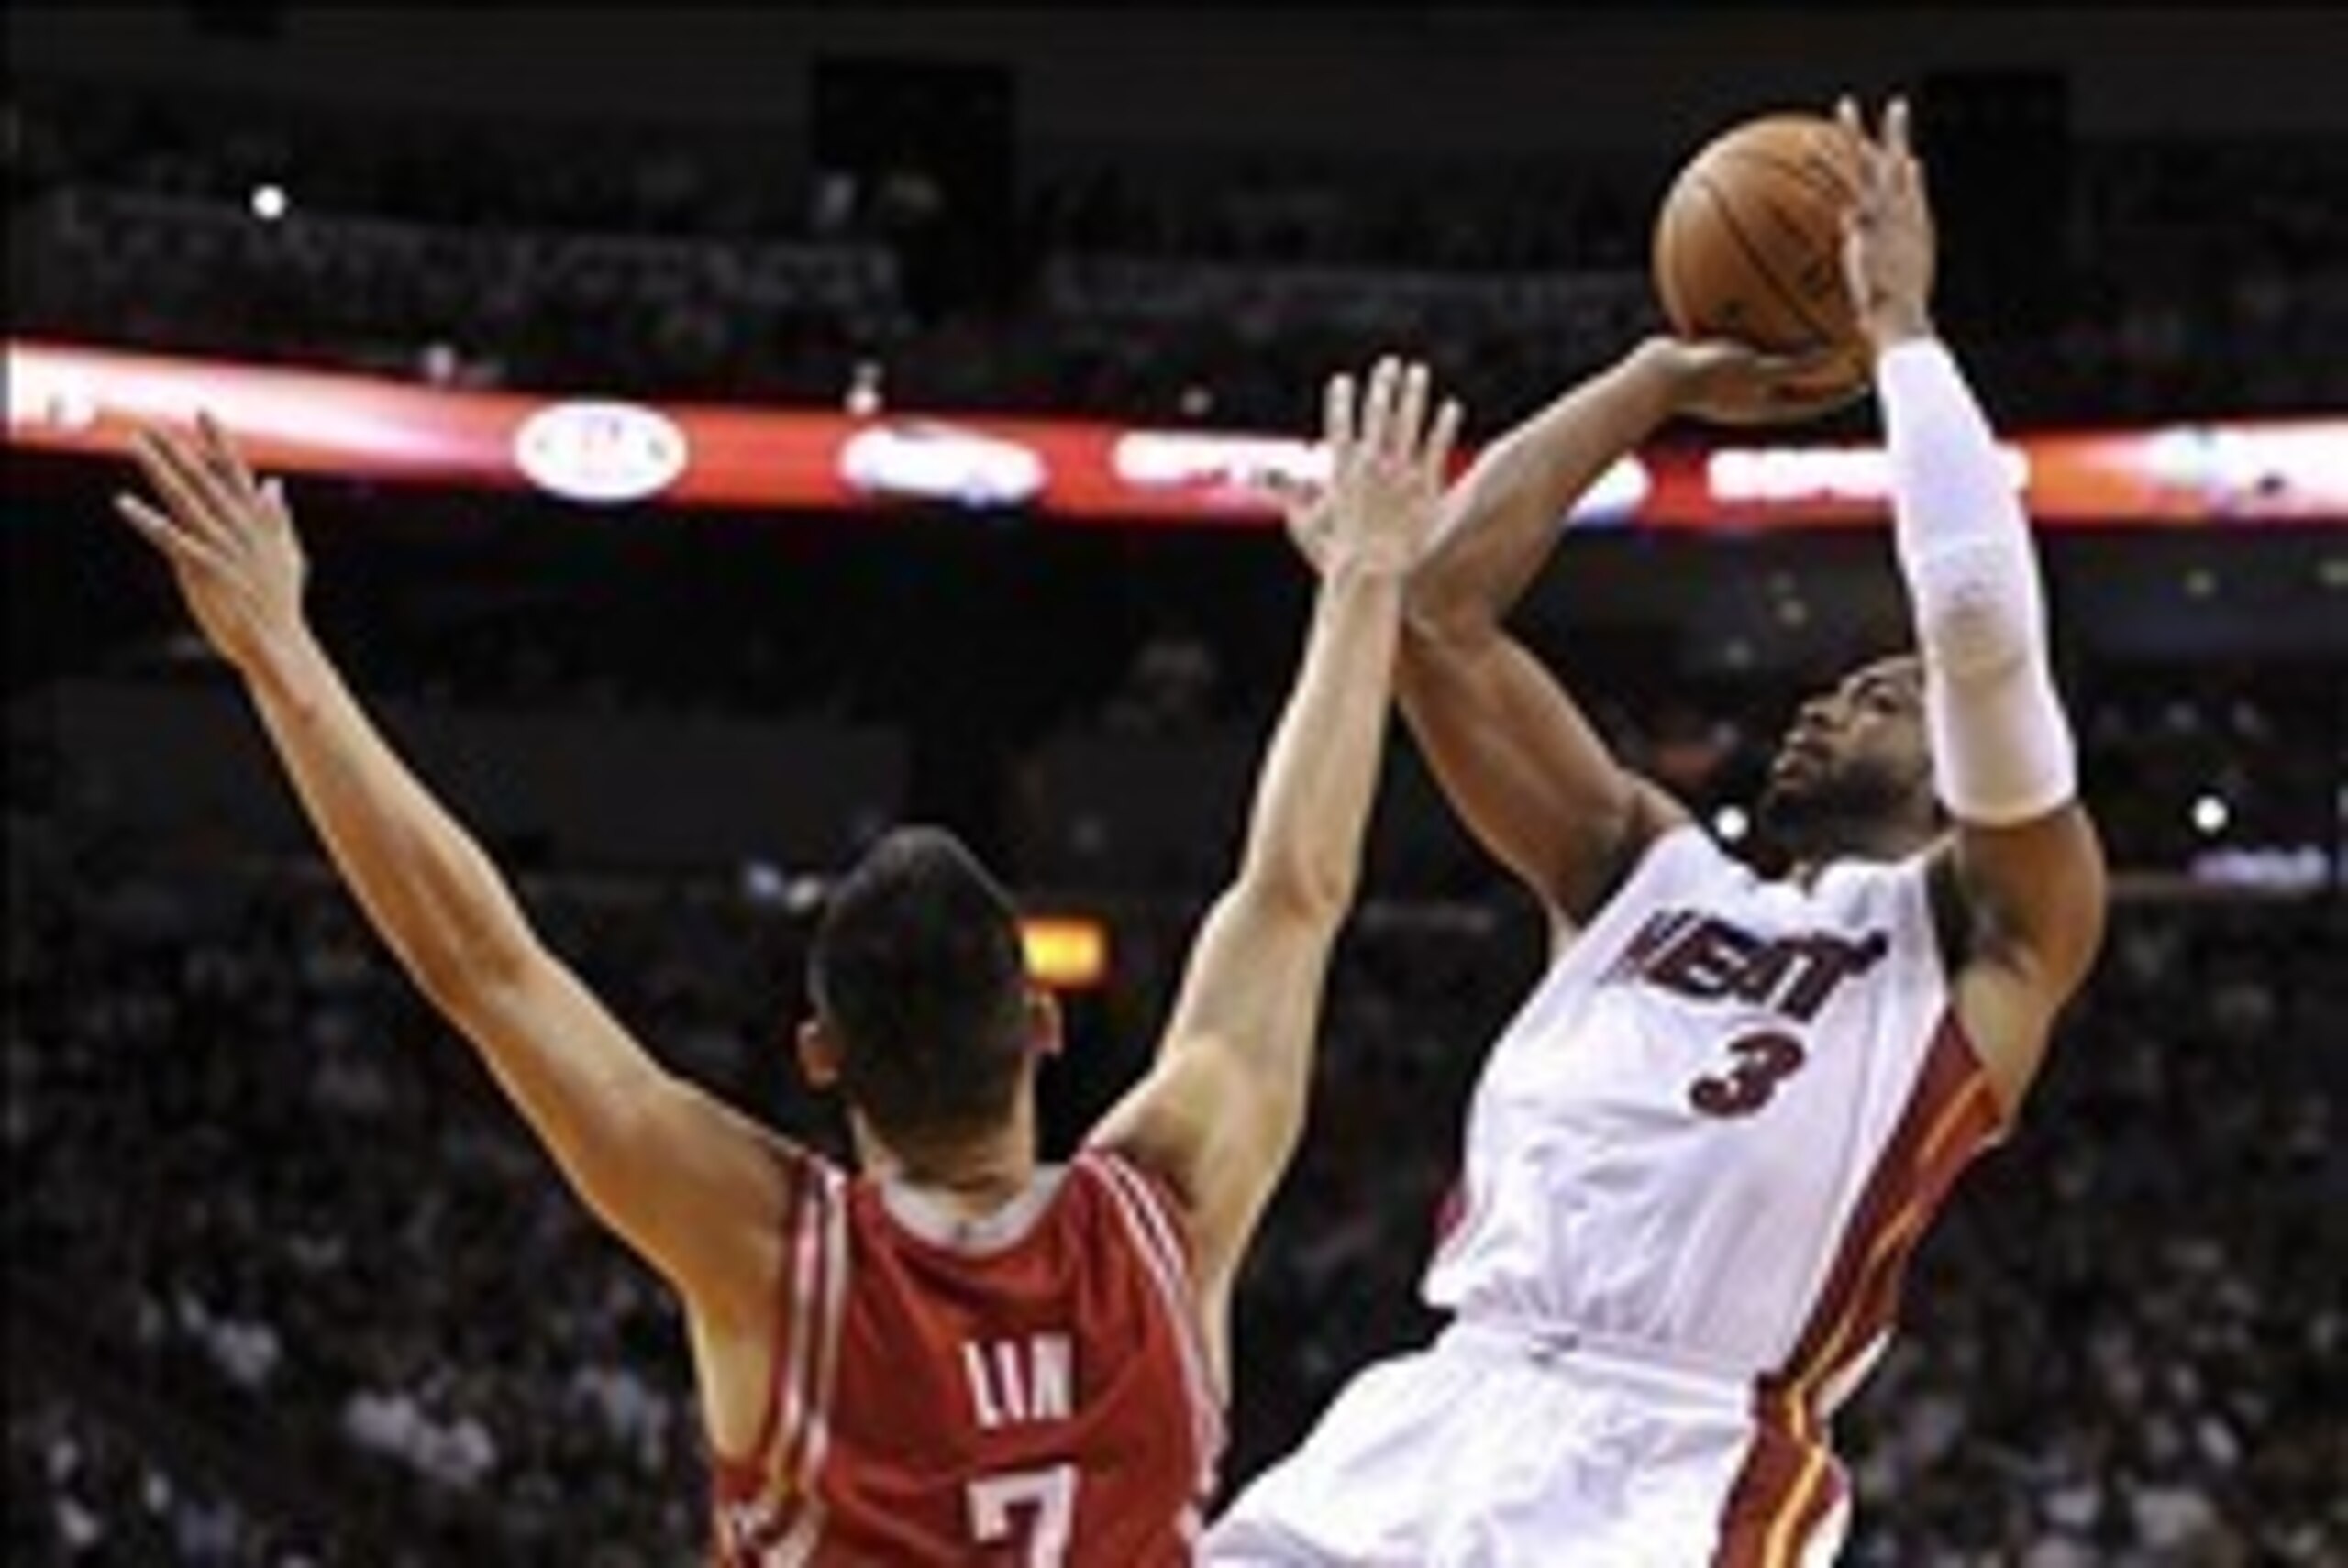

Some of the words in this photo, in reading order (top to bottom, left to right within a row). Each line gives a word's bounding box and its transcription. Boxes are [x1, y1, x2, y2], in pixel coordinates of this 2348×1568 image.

[1620, 908, 1888, 1023] HEAT
[1689, 1032, 1806, 1116] 3
[962, 1333, 1073, 1428] LIN
[968, 1464, 1078, 1568] 7
